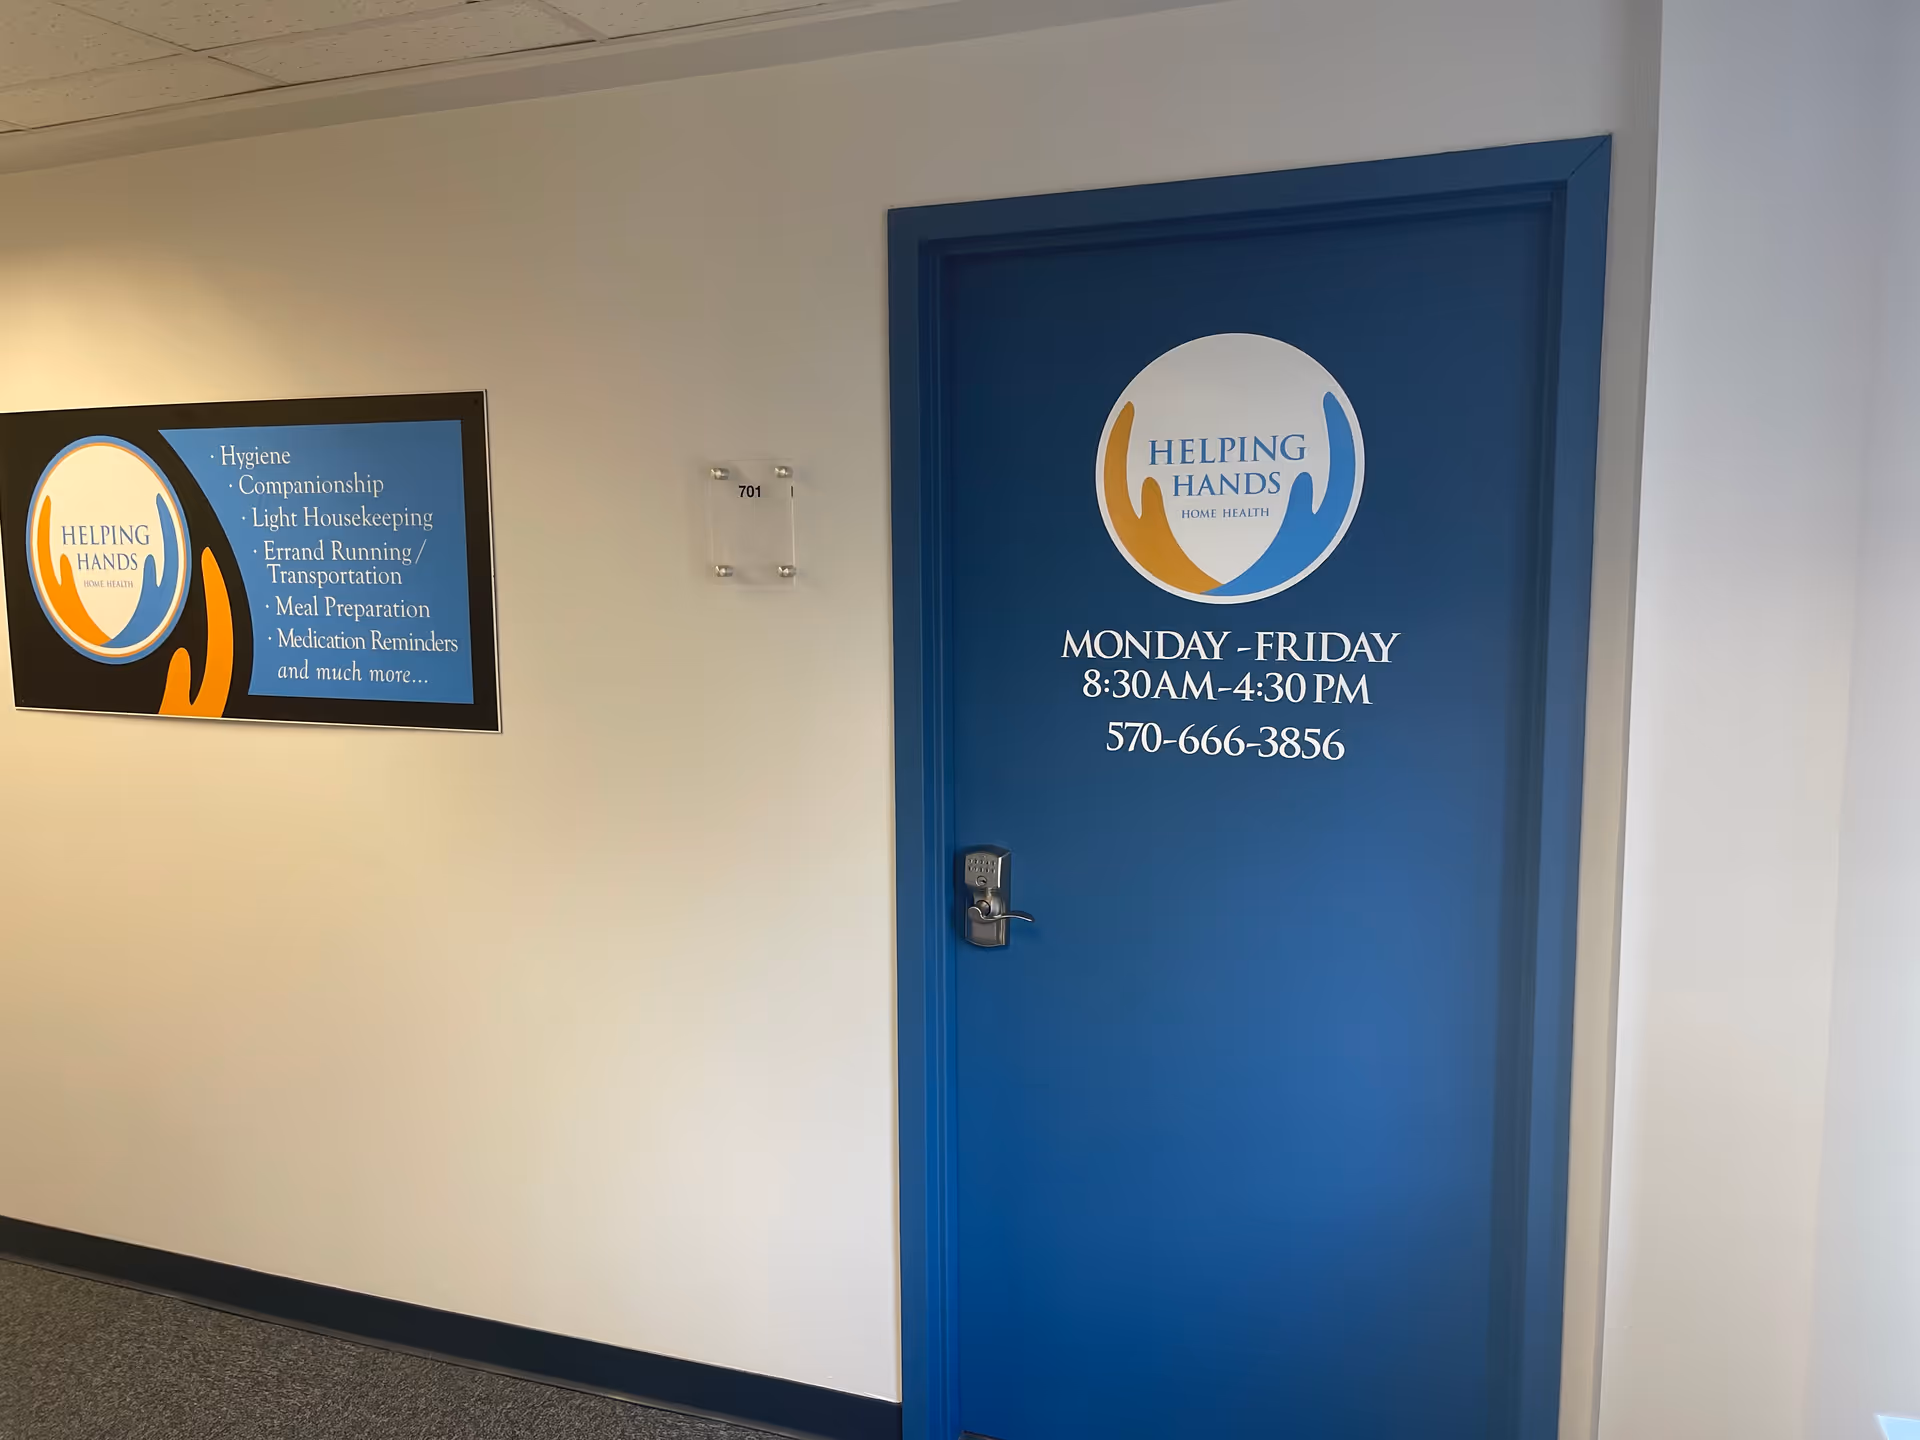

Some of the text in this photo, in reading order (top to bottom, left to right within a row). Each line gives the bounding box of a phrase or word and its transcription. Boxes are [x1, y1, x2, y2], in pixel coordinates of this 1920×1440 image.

[221, 445, 290, 468] Hygiene
[1149, 434, 1306, 465] HELPING
[239, 473, 383, 499] Companionship
[739, 485, 760, 497] 701
[1174, 472, 1280, 496] HANDS
[252, 505, 432, 531] Light Housekeeping
[1182, 508, 1268, 518] HOME HEALTH
[62, 525, 149, 545] HELPING
[78, 553, 137, 570] HANDS
[264, 540, 324, 560] Errand
[84, 580, 134, 588] HOME HEALTH
[267, 563, 402, 588] Transportation
[275, 596, 430, 621] Meal Preparation
[277, 628, 458, 651] Medication Reminders
[1061, 630, 1231, 660] MONDAY
[278, 660, 309, 679] and
[316, 661, 362, 681] much
[1107, 722, 1345, 760] 570-666-3856
